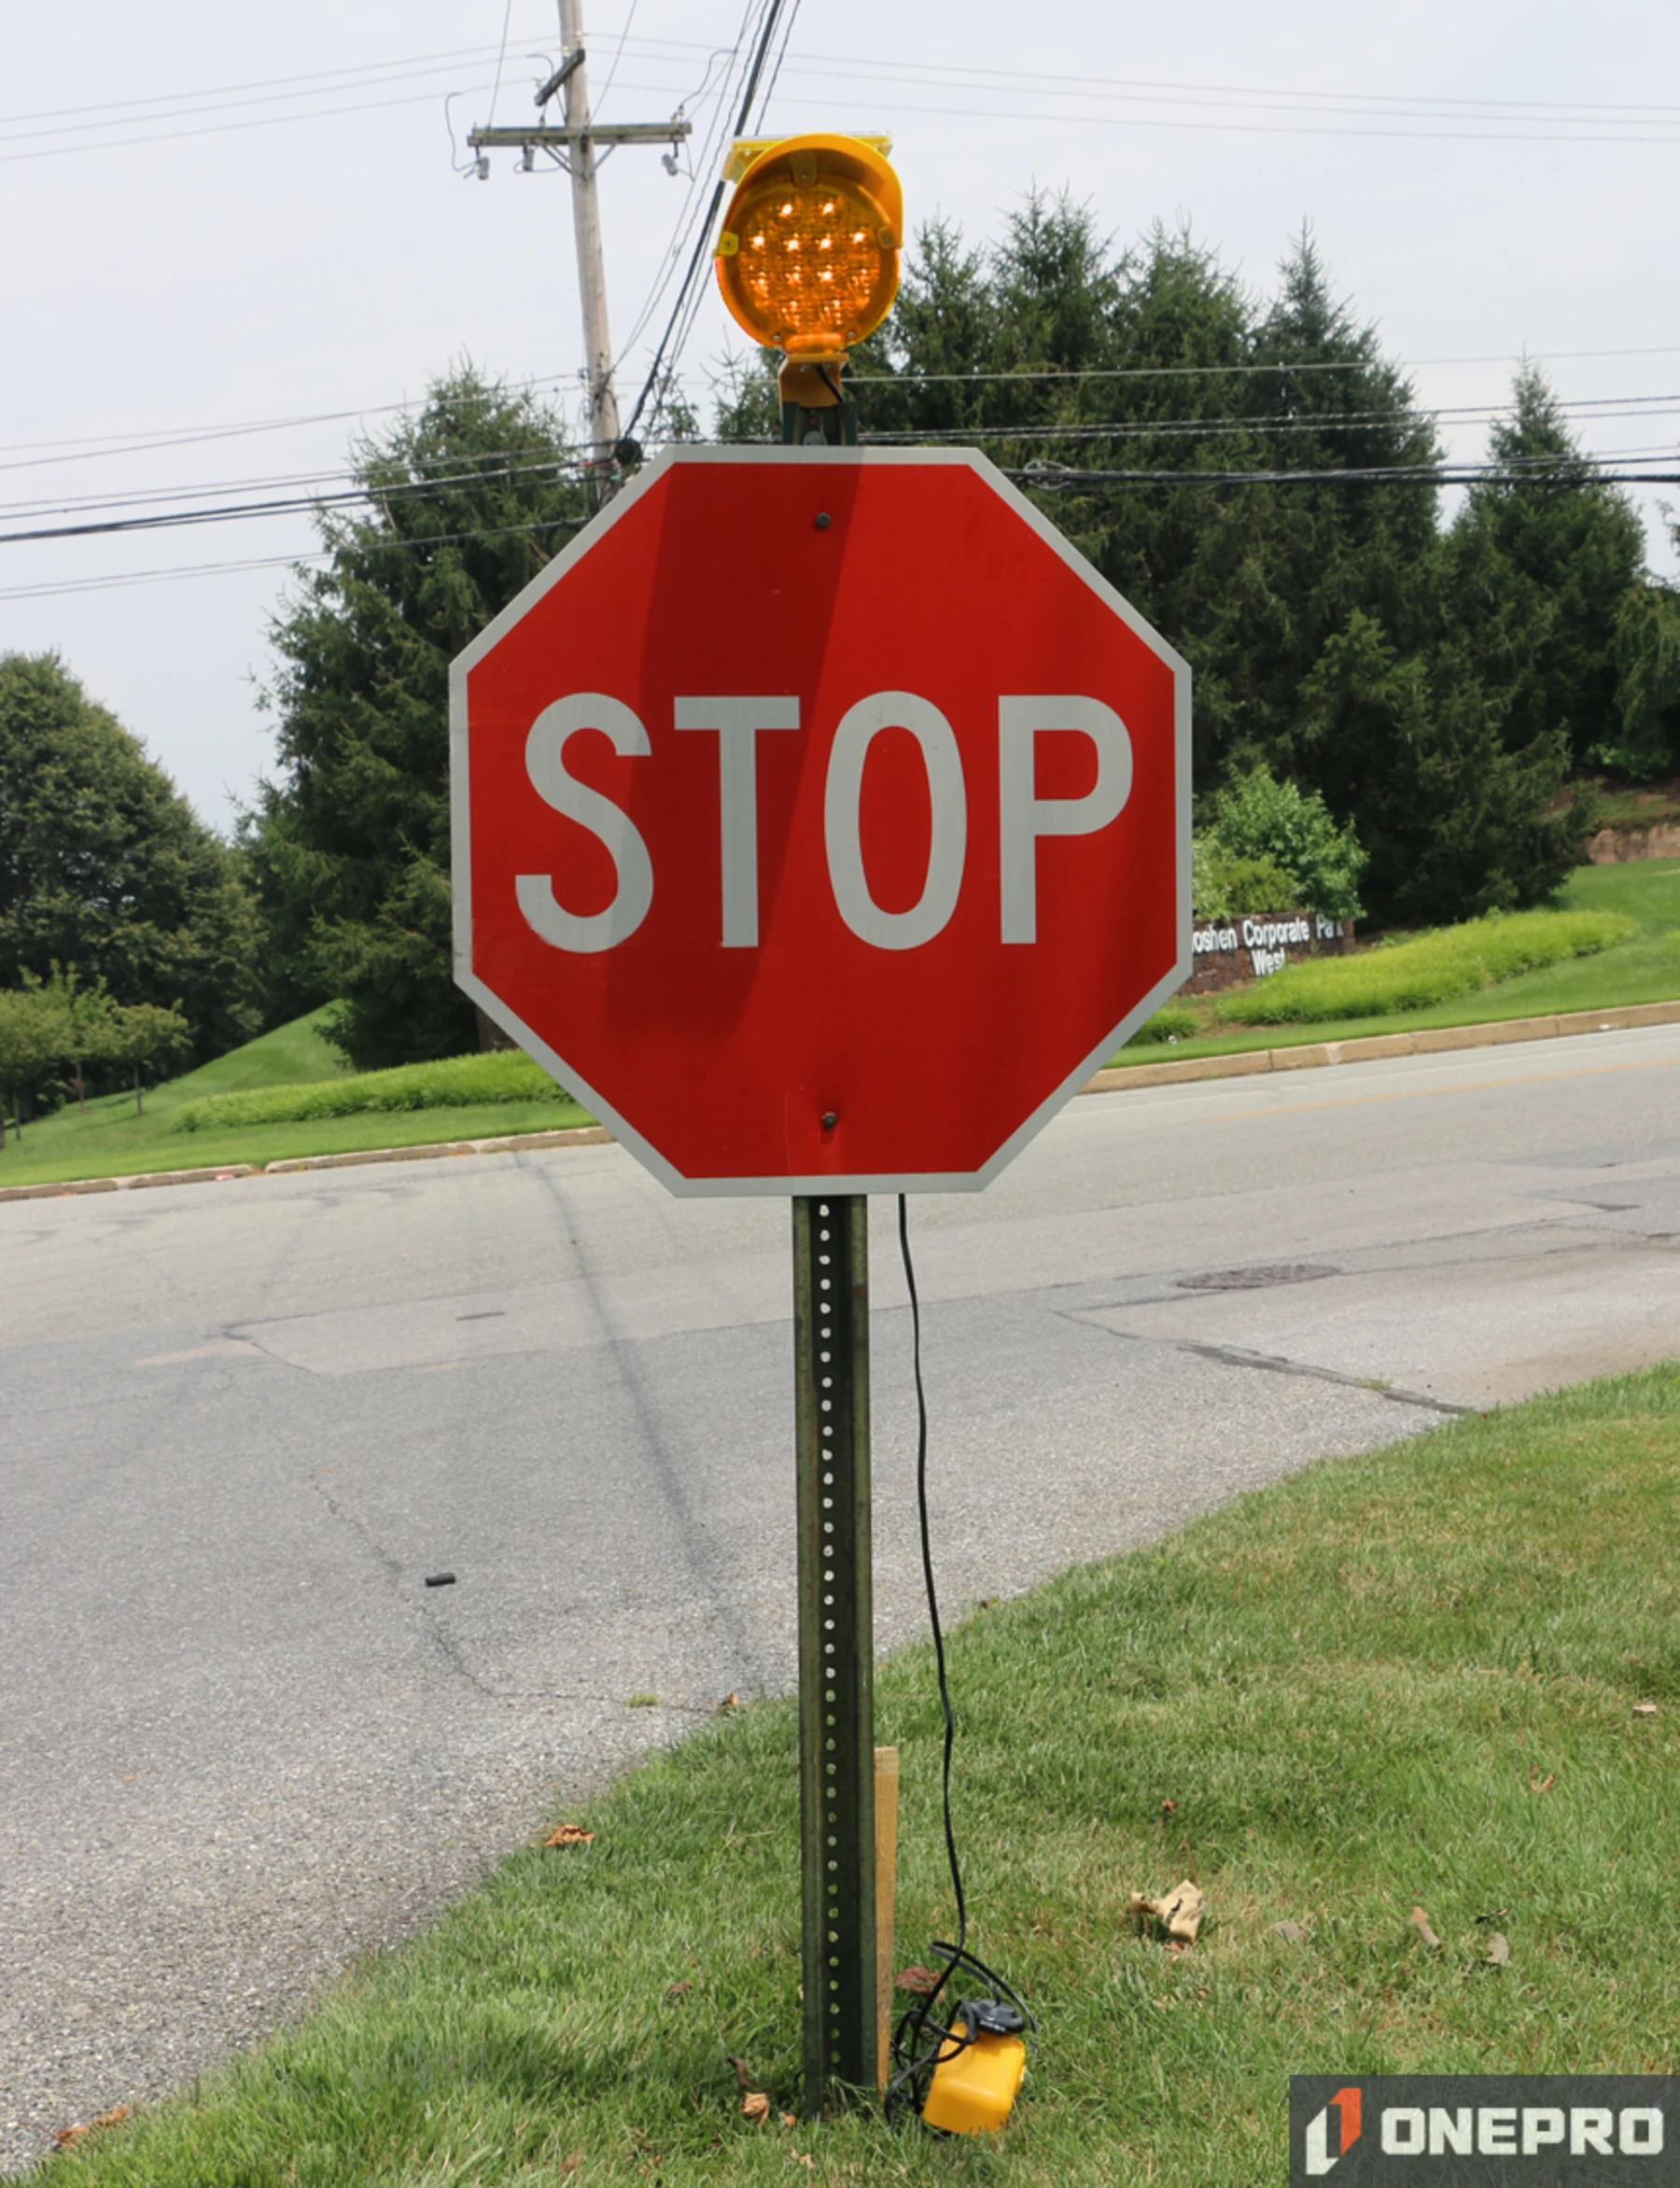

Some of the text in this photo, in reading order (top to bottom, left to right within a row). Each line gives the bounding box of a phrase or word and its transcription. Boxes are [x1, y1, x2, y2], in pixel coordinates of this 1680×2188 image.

[514, 691, 1134, 954] STOP
[1192, 922, 1239, 952] oshen
[1242, 918, 1309, 950] Corporate
[1251, 947, 1285, 976] West
